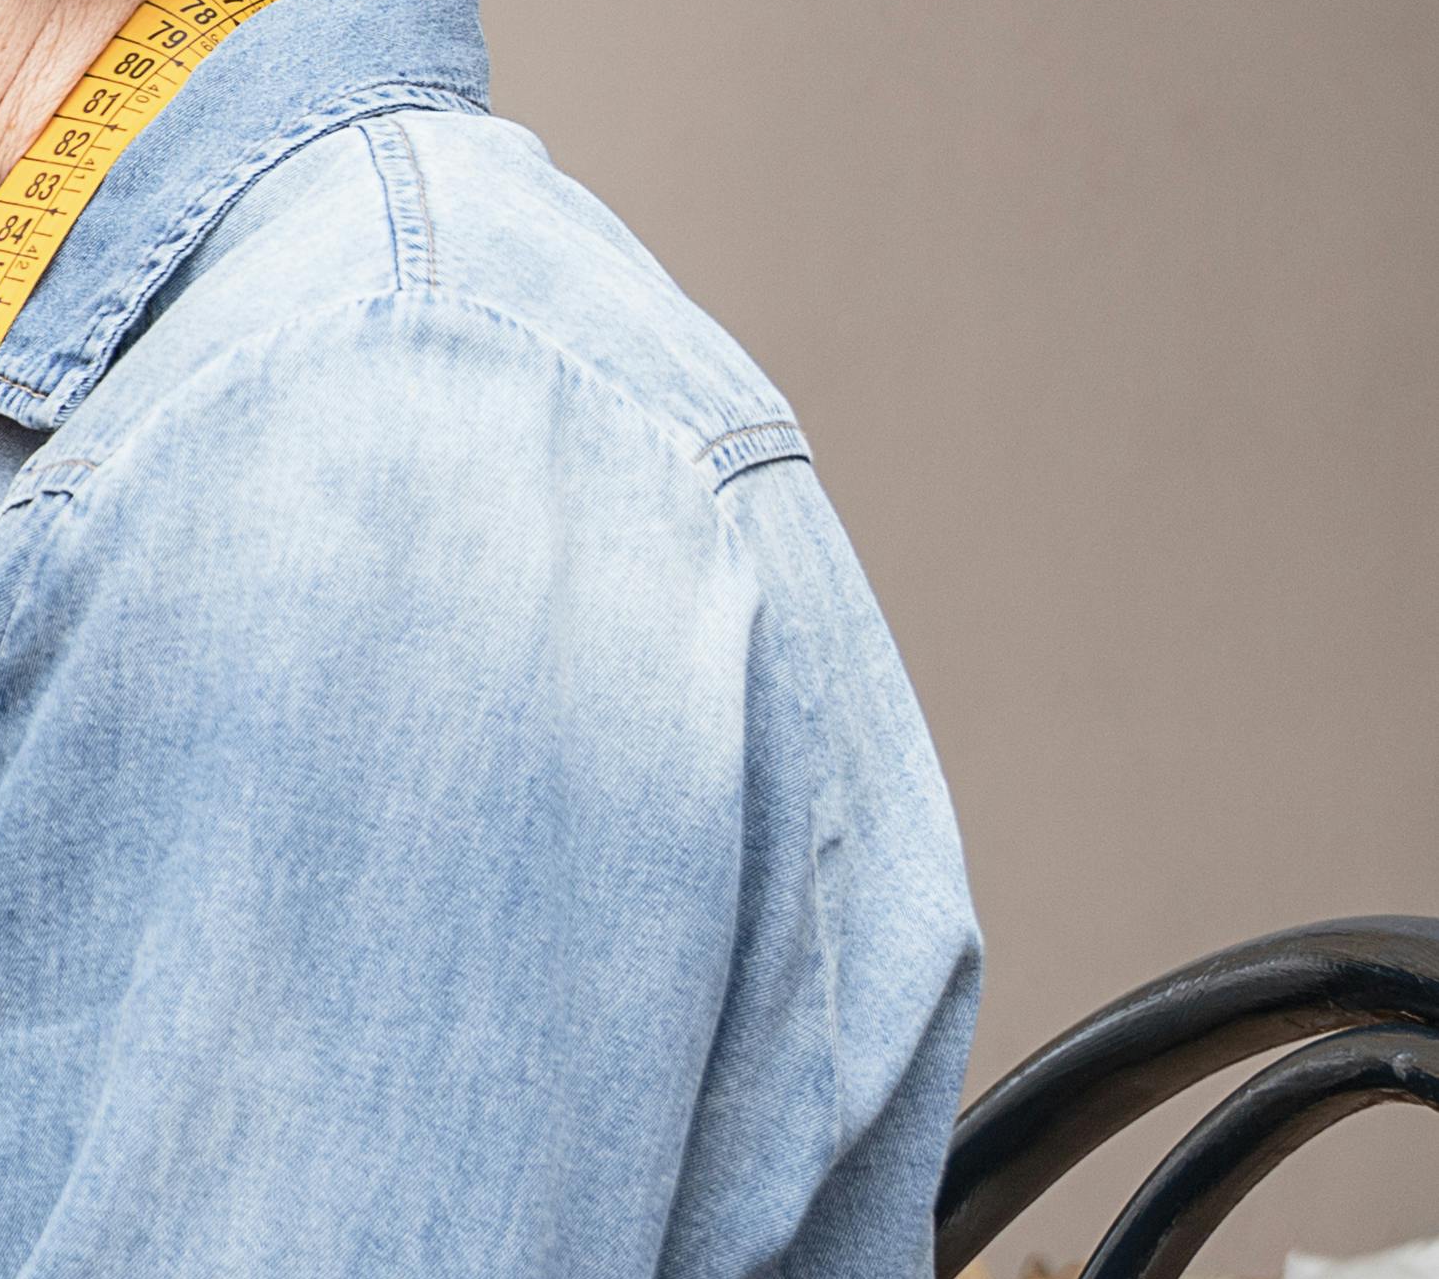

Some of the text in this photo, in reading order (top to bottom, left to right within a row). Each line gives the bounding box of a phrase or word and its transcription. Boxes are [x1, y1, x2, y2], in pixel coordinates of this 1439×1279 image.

[148, 20, 188, 49] 79
[114, 53, 155, 79] 80
[84, 89, 121, 116] 81
[54, 130, 90, 157] 82
[25, 172, 60, 200] 83
